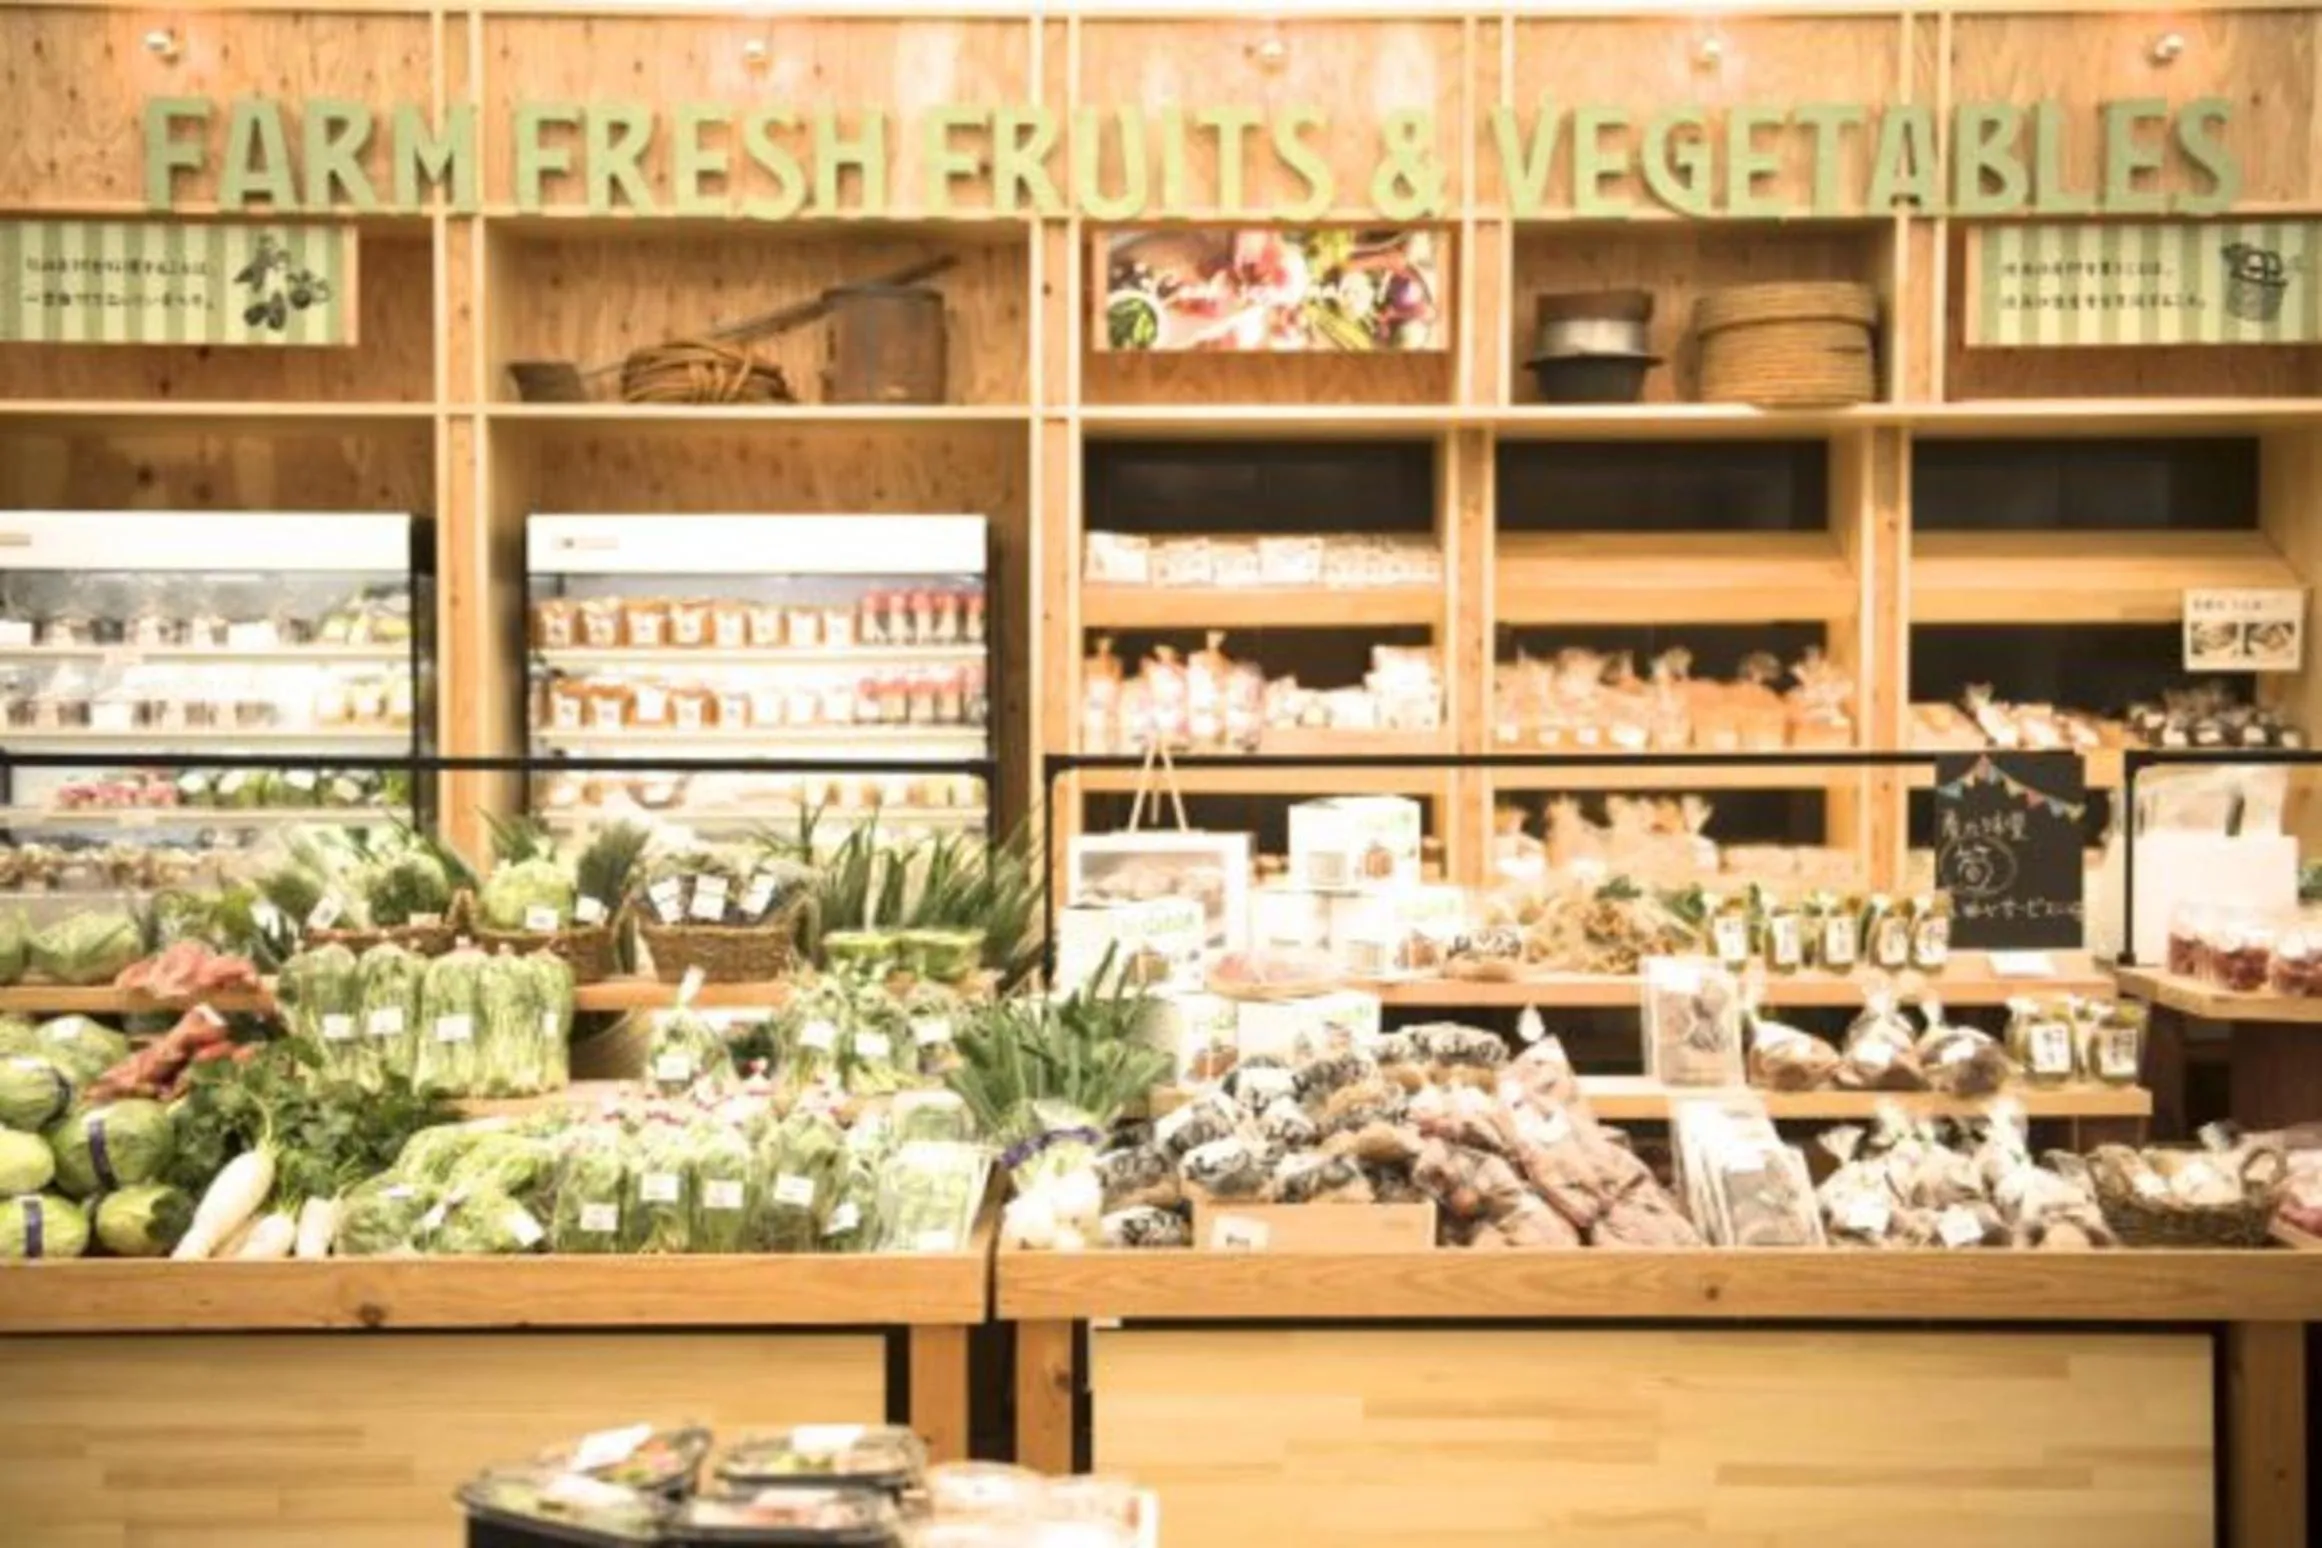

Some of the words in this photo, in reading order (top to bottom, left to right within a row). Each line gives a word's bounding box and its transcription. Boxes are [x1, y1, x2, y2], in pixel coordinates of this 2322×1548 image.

[144, 95, 480, 213] FARM
[512, 101, 888, 219] FRESH
[922, 101, 1338, 220] FRUITS
[1369, 105, 1450, 220] &
[1494, 97, 2244, 220] VEGETABLES
